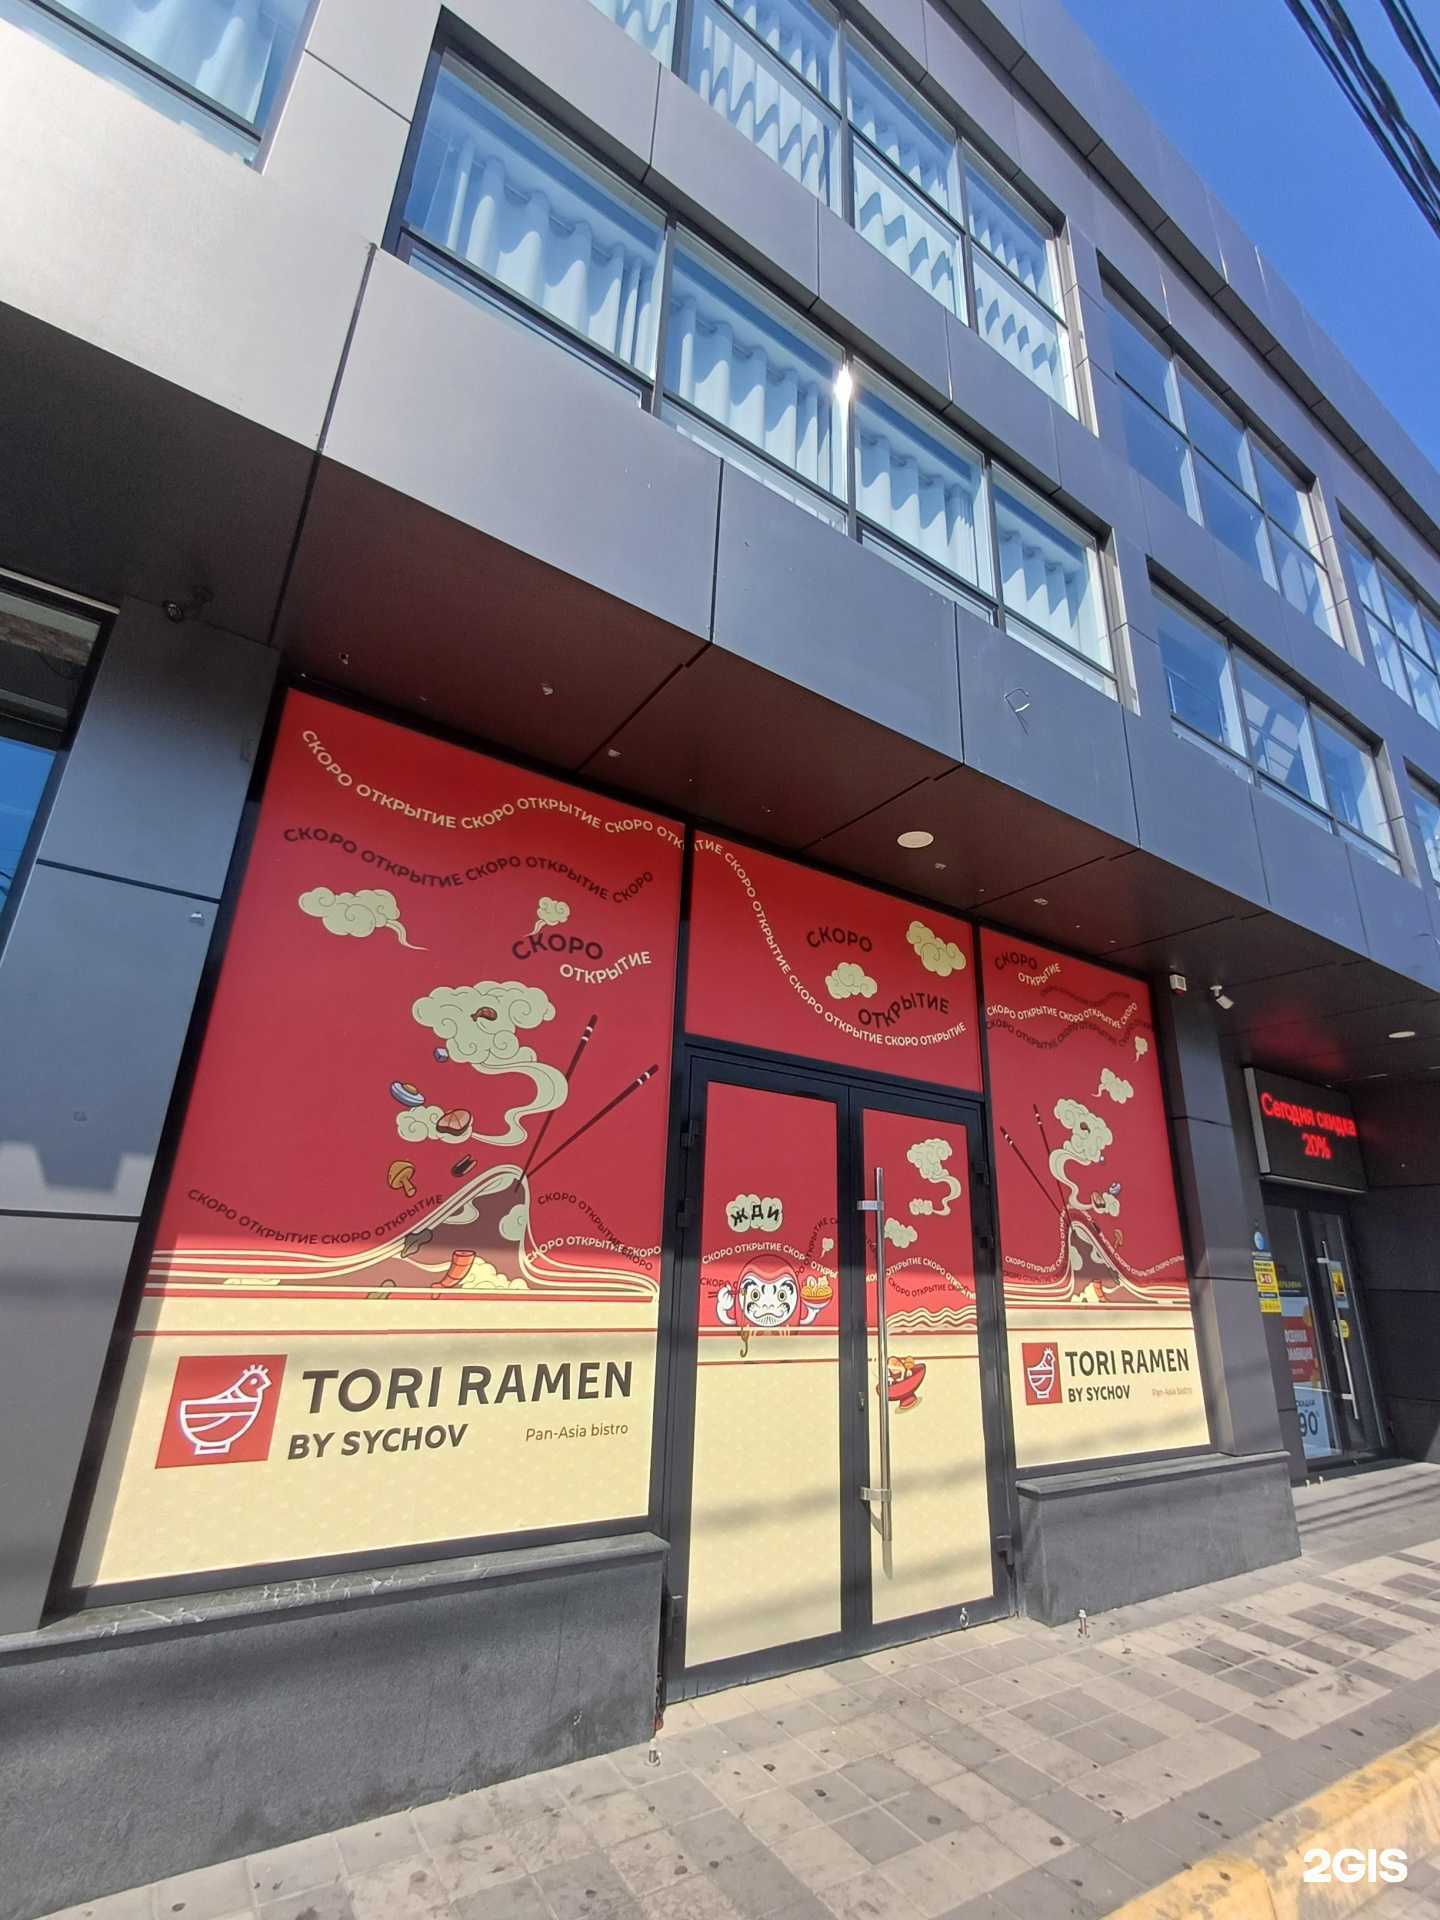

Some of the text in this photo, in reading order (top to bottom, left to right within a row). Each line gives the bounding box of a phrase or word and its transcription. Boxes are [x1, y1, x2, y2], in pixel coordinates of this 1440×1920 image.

[283, 826, 654, 903] СКОРО ОТКРЫТИЕ СКОРО ОТКРЫТИЕ СКОРО
[302, 730, 353, 786] СКОРО
[356, 783, 457, 829] ОТКРЫТИЕ
[461, 802, 515, 830] СКОРО
[516, 796, 601, 829] ОТКРЫТИЕ
[604, 818, 653, 834] СКОРО
[724, 852, 756, 898] СКОРО
[752, 900, 792, 975] ОТКРЫТИЕ
[788, 974, 824, 1014] СКОРО
[824, 1011, 884, 1044] ОТКРЫТИЕ
[884, 1034, 919, 1047] СКОРО
[919, 1022, 967, 1046] ОТКРЫТИЕ
[512, 932, 604, 960] СКОРО
[806, 926, 873, 953] СКОРО
[559, 951, 652, 984] ОТКРЫТИЕ
[994, 951, 1038, 971] СКОРО
[1017, 962, 1061, 987] ОТКРЫТИЕ
[857, 992, 950, 1029] ОТКРЫТИЕ
[986, 1004, 1016, 1019] СКОРО
[1017, 1005, 1058, 1021] ОТКРЫТИЕ
[1058, 1010, 1084, 1022] СКОРО
[1083, 1008, 1122, 1029] ОТКРЫТИЕ
[1260, 1091, 1315, 1128] Сегодня
[1301, 1132, 1333, 1160] 20%
[537, 1191, 577, 1206] СКОРО
[187, 1188, 443, 1245] СКОРО ОТКРЫТИЕ СКОРО ОТКРЫТИЕ
[730, 1204, 780, 1227] ЖДИ
[566, 1235, 624, 1253] ОТКРЫТИЕ
[702, 1246, 733, 1265] СКОРО
[734, 1242, 782, 1254] ОТКРЫТИЕ
[922, 1257, 946, 1277] СКОРО
[888, 1277, 911, 1297] СКОРО
[911, 1284, 947, 1298] ОТКРЫТИЕ
[1064, 1348, 1190, 1377] TORI RAMEN
[301, 1360, 634, 1414] TORI RAMEN
[1068, 1384, 1131, 1403] BY SYCHOV
[287, 1422, 469, 1461] BY SYCHOV
[524, 1420, 629, 1443] Pan-Asia bistro
